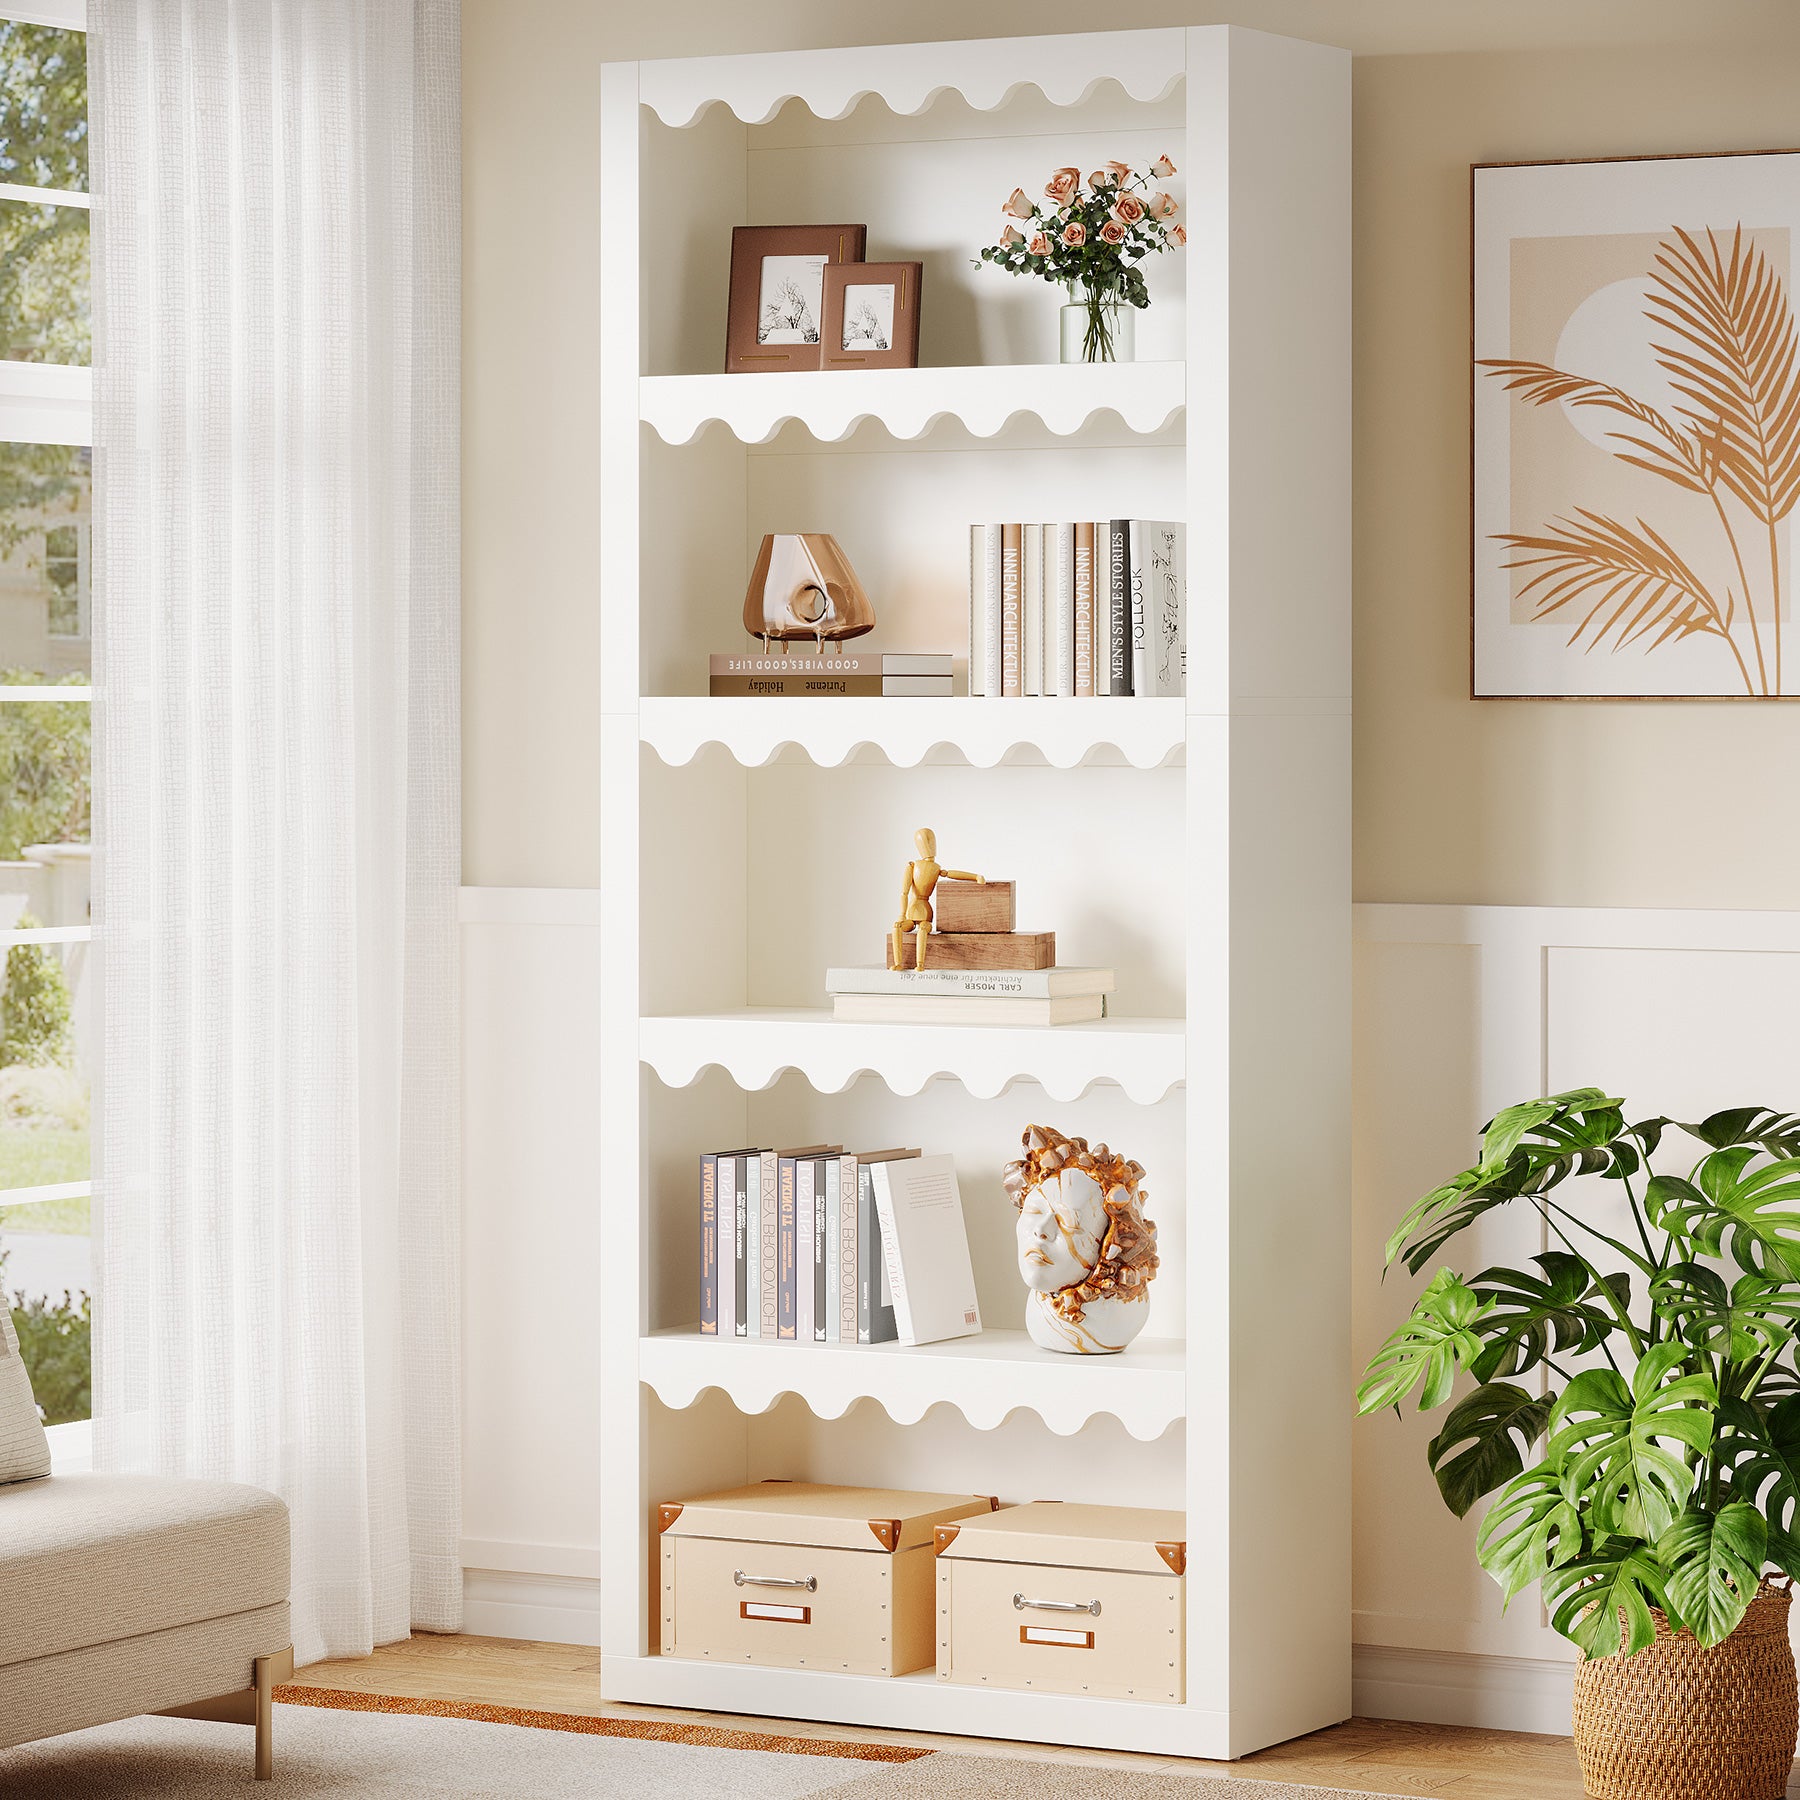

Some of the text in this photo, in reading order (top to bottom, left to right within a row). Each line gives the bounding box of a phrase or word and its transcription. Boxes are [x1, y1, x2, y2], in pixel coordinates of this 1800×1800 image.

[1059, 531, 1067, 598] REVOLUTION
[1003, 548, 1017, 688] INNENARCHITEKTUR
[1059, 601, 1067, 631] LOOK
[1076, 547, 1090, 688] INNENARCHITEKTUR
[1112, 532, 1124, 680] MEN'S STYLE STORIES
[1132, 568, 1145, 650] POLLOCK
[729, 660, 752, 670] LIFE
[826, 660, 859, 670] GOOD
[748, 678, 846, 692] Purienne Holiday
[965, 982, 1022, 991] CARL MOSER
[976, 973, 1023, 983] Architektur
